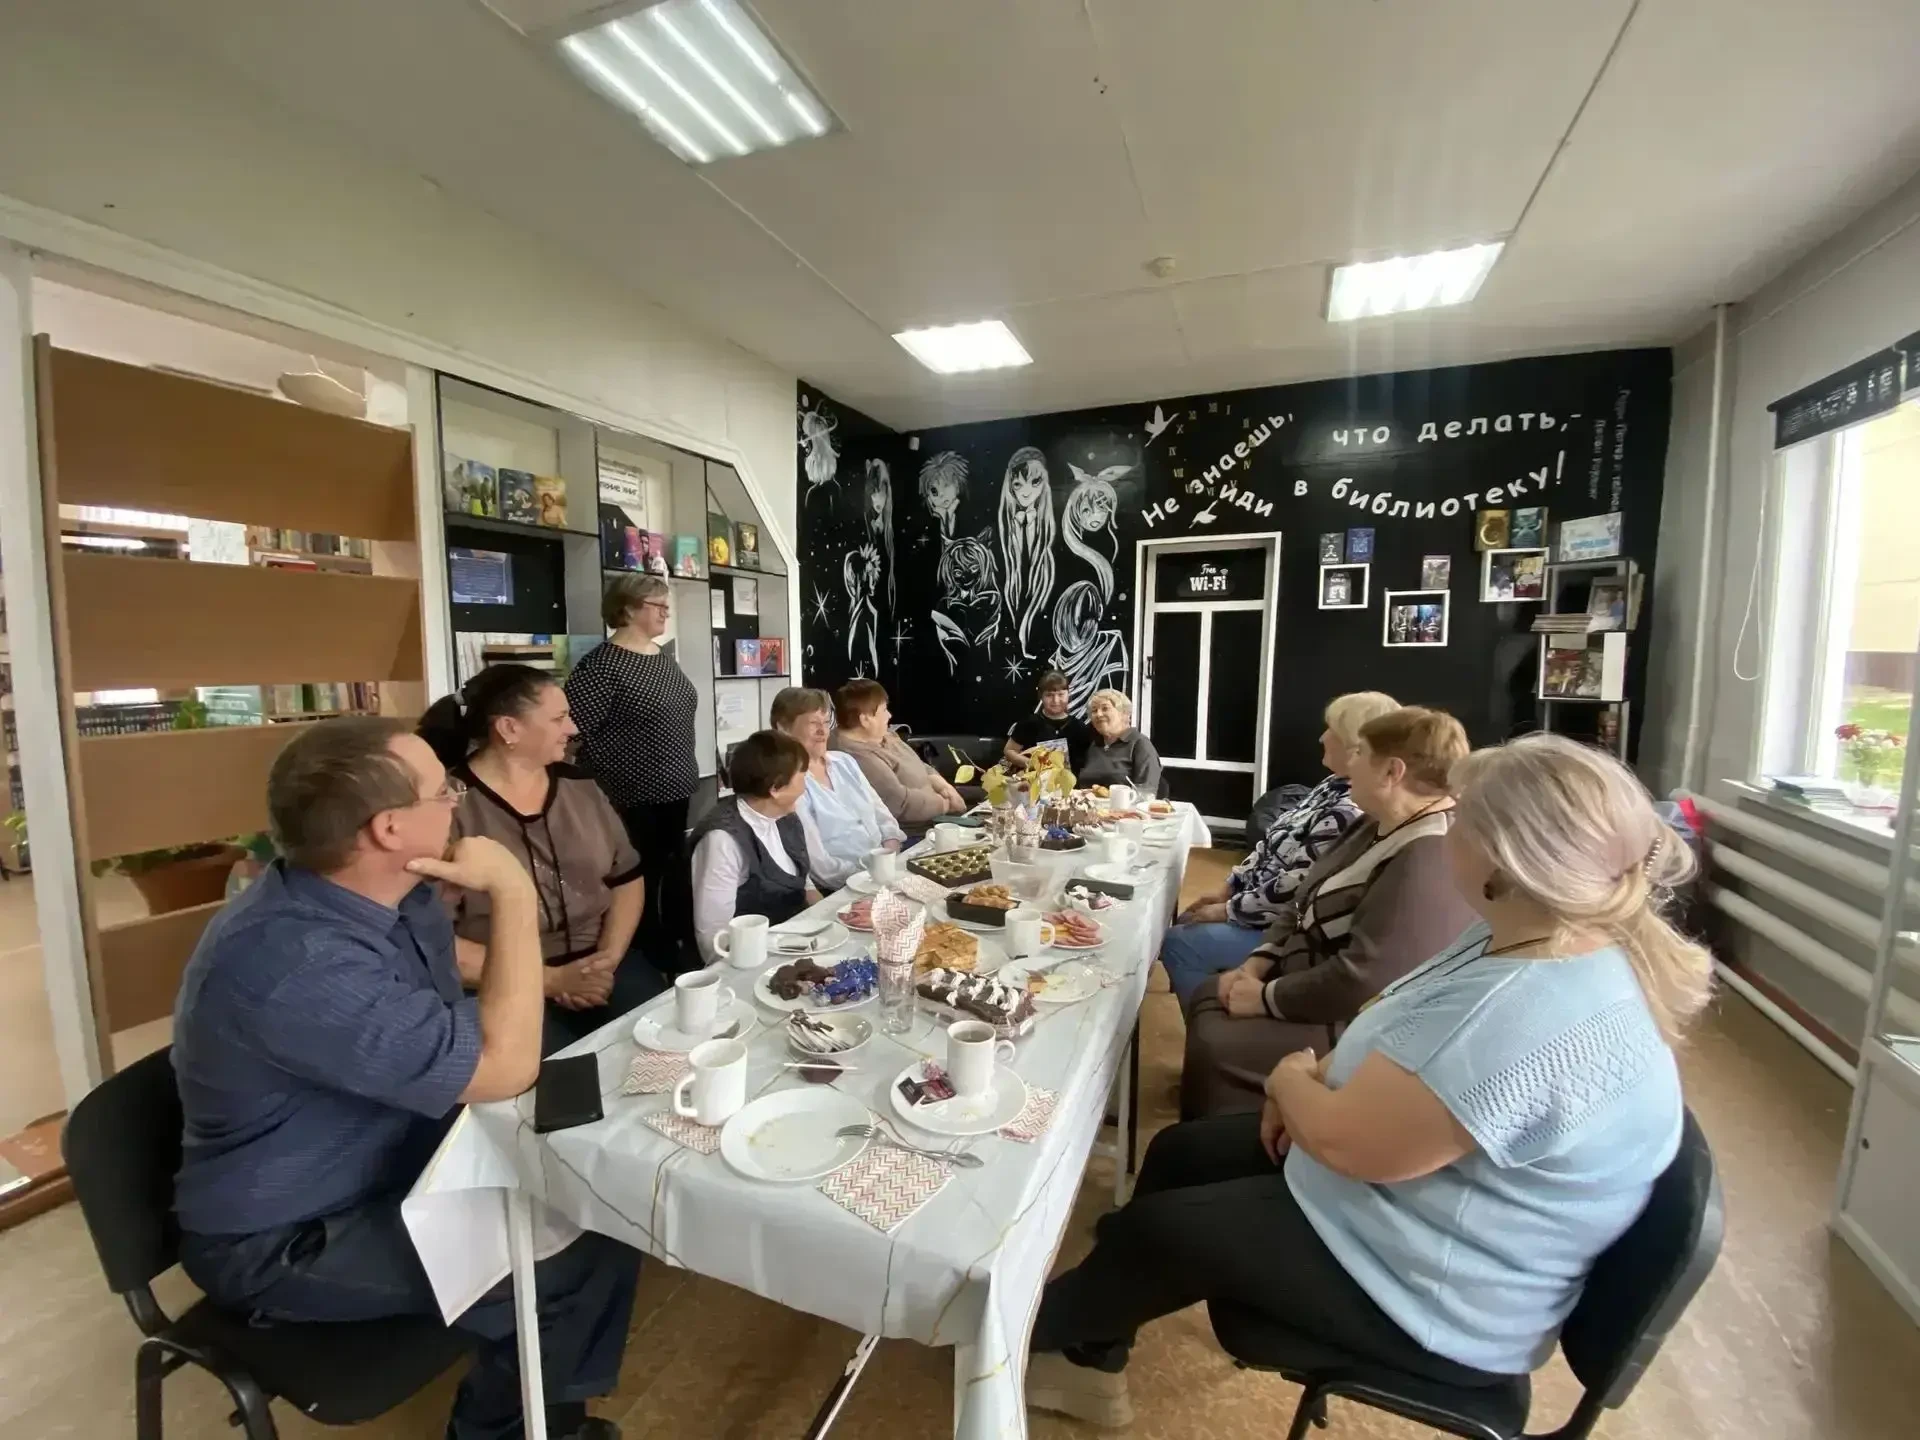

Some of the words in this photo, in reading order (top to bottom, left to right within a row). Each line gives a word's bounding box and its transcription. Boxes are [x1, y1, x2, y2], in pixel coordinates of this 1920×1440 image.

[1141, 497, 1180, 528] Не
[1189, 413, 1293, 494] знаешь,
[1332, 426, 1390, 446] что
[1219, 484, 1274, 517] иди
[1294, 480, 1308, 496] в
[1331, 450, 1565, 519] библиотеку!
[1189, 575, 1227, 592] Wi-Fi
[1200, 563, 1217, 575] Free
